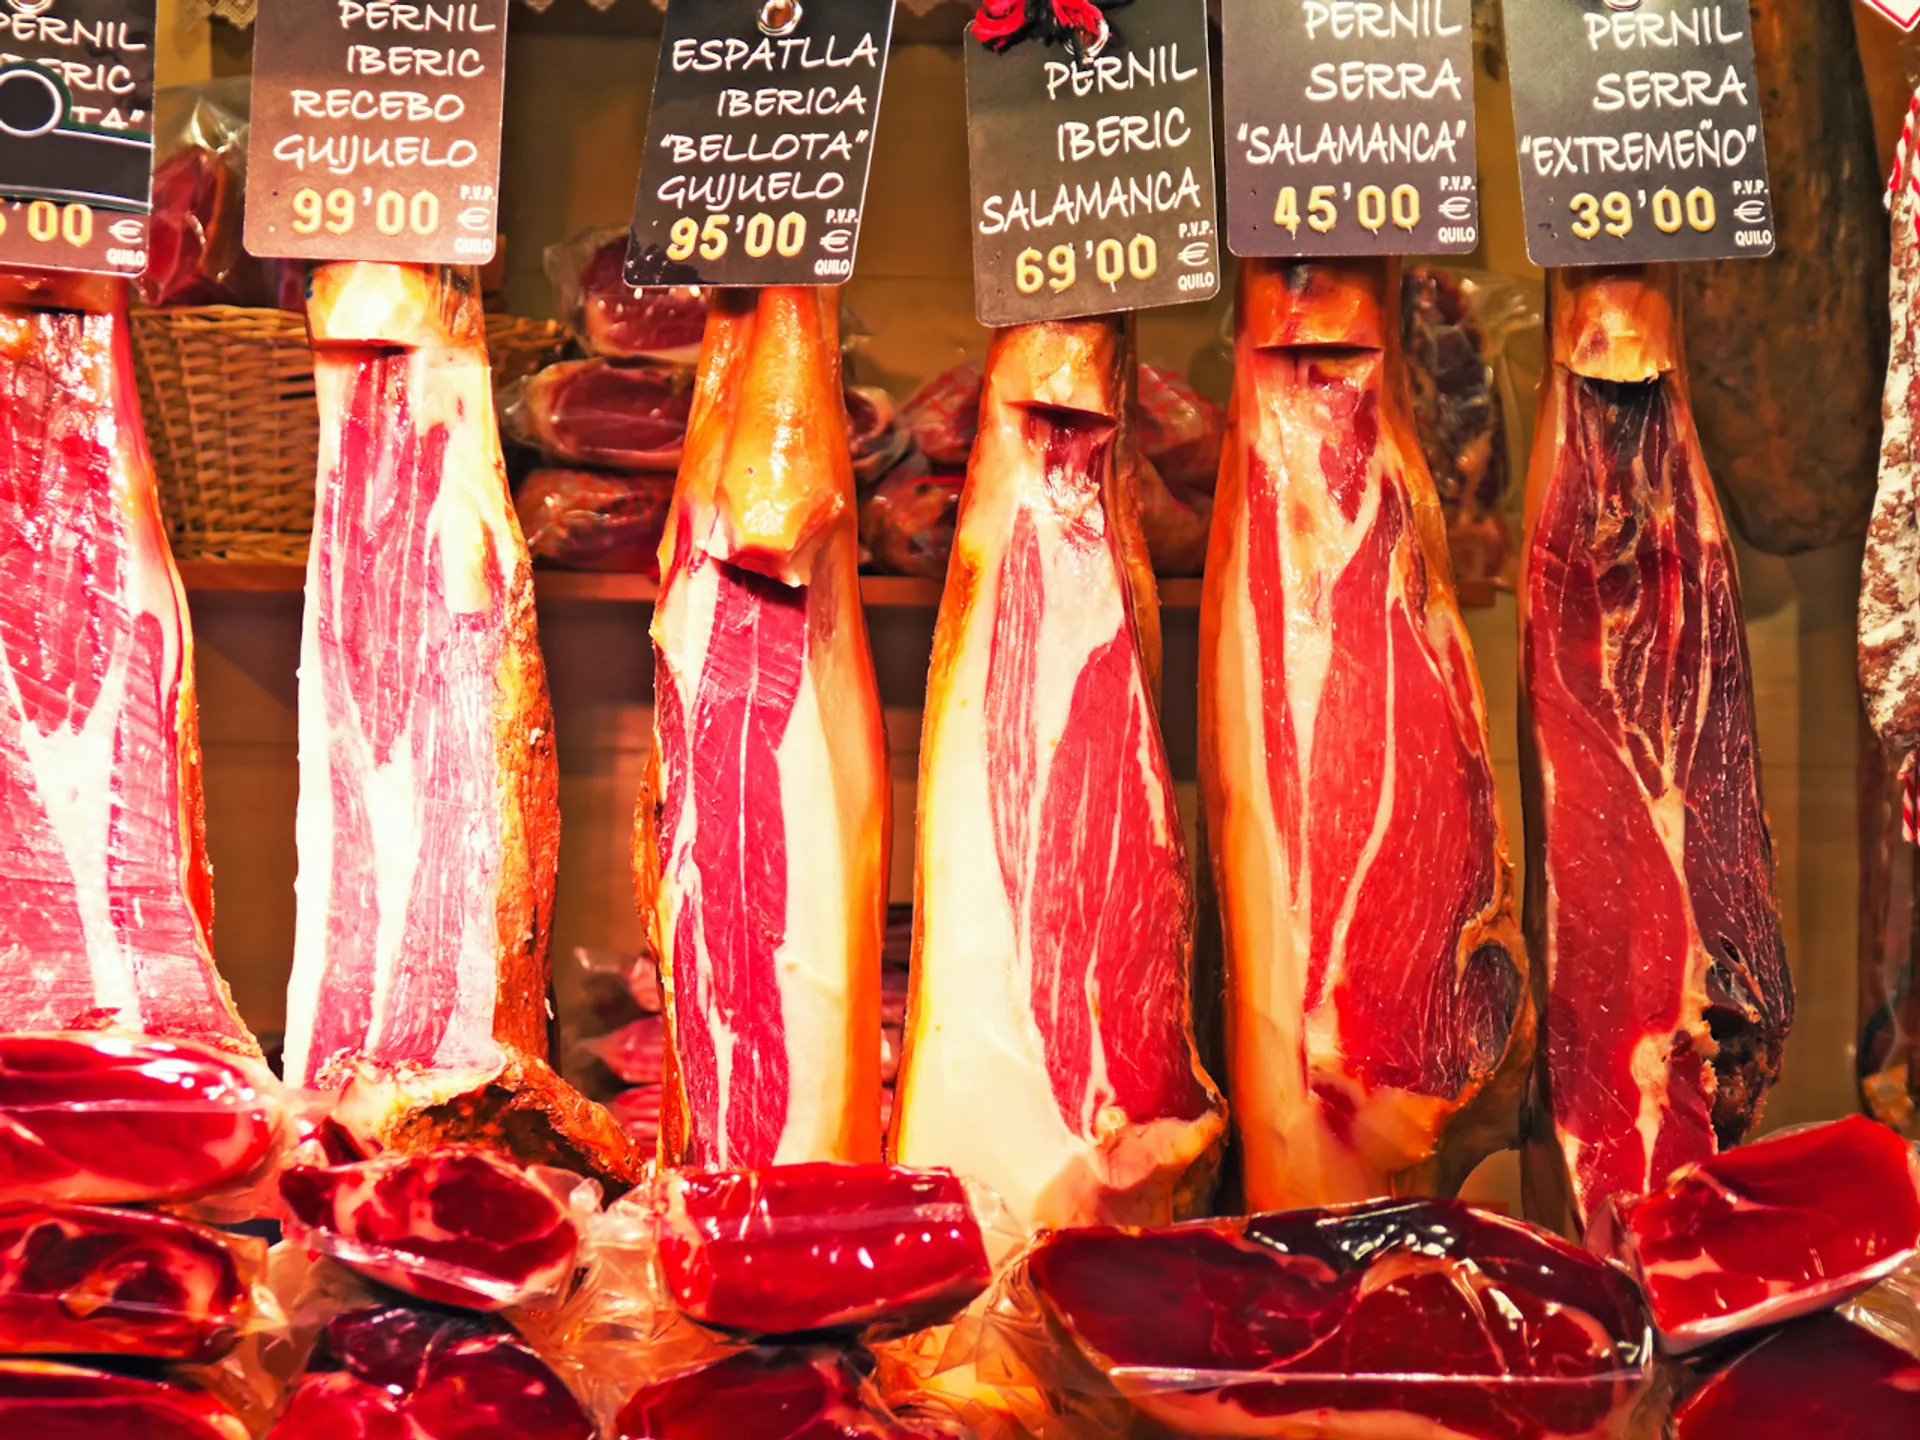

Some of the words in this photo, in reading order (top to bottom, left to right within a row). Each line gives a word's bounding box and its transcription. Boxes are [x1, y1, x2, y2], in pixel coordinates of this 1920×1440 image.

[338, 0, 496, 31] PERNIL
[1303, 1, 1462, 39] PERNIL
[1583, 6, 1743, 50] PERNIL
[347, 45, 485, 77] IBERIC
[672, 32, 878, 71] ESPATLLA
[1044, 42, 1198, 100] PERNIL
[1305, 58, 1462, 100] SERRA
[717, 85, 867, 117] IBERICA
[1593, 65, 1748, 110] SERRA
[291, 89, 465, 122] RECEBO
[1057, 106, 1191, 161] IBERIC
[273, 134, 478, 175] GUIJUELO
[460, 185, 496, 201] P.V.P.
[657, 172, 844, 211] GUIJUELO
[1440, 176, 1476, 191] P.V.P.
[1733, 180, 1769, 195] P.V.P.
[979, 166, 1201, 234] SALAMANCA
[826, 209, 859, 224] P.V.P.
[1178, 220, 1214, 239] P.V.P.
[454, 237, 493, 254] QUILO
[1438, 227, 1476, 243] QUILO
[1735, 229, 1772, 246] QUILO
[106, 248, 146, 266] QUILO
[814, 258, 850, 276] QUILO
[1177, 272, 1215, 291] QUILO
